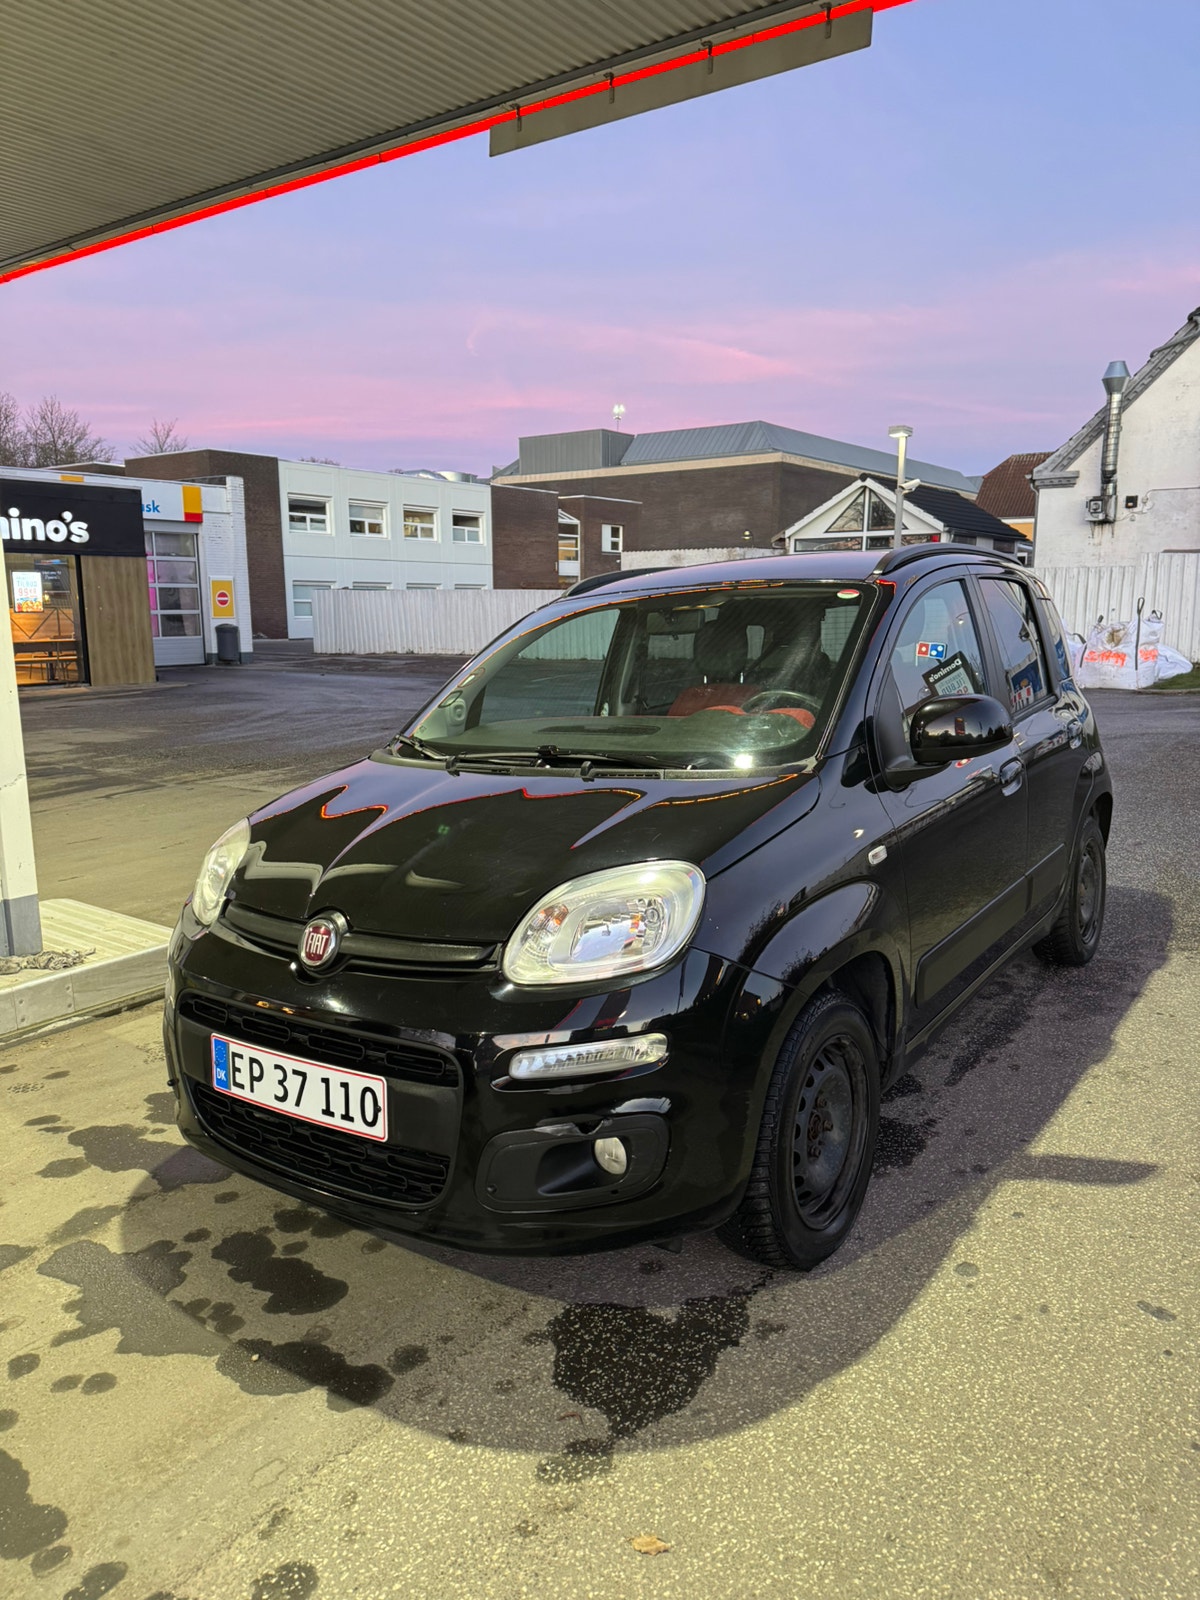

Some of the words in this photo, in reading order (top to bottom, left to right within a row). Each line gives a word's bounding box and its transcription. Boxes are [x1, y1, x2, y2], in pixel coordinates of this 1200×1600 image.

[0, 507, 89, 543] ino's
[306, 932, 329, 955] FIAT
[216, 1068, 227, 1082] DK
[231, 1051, 264, 1093] EP
[273, 1064, 307, 1107] 37
[320, 1077, 379, 1127] 110
